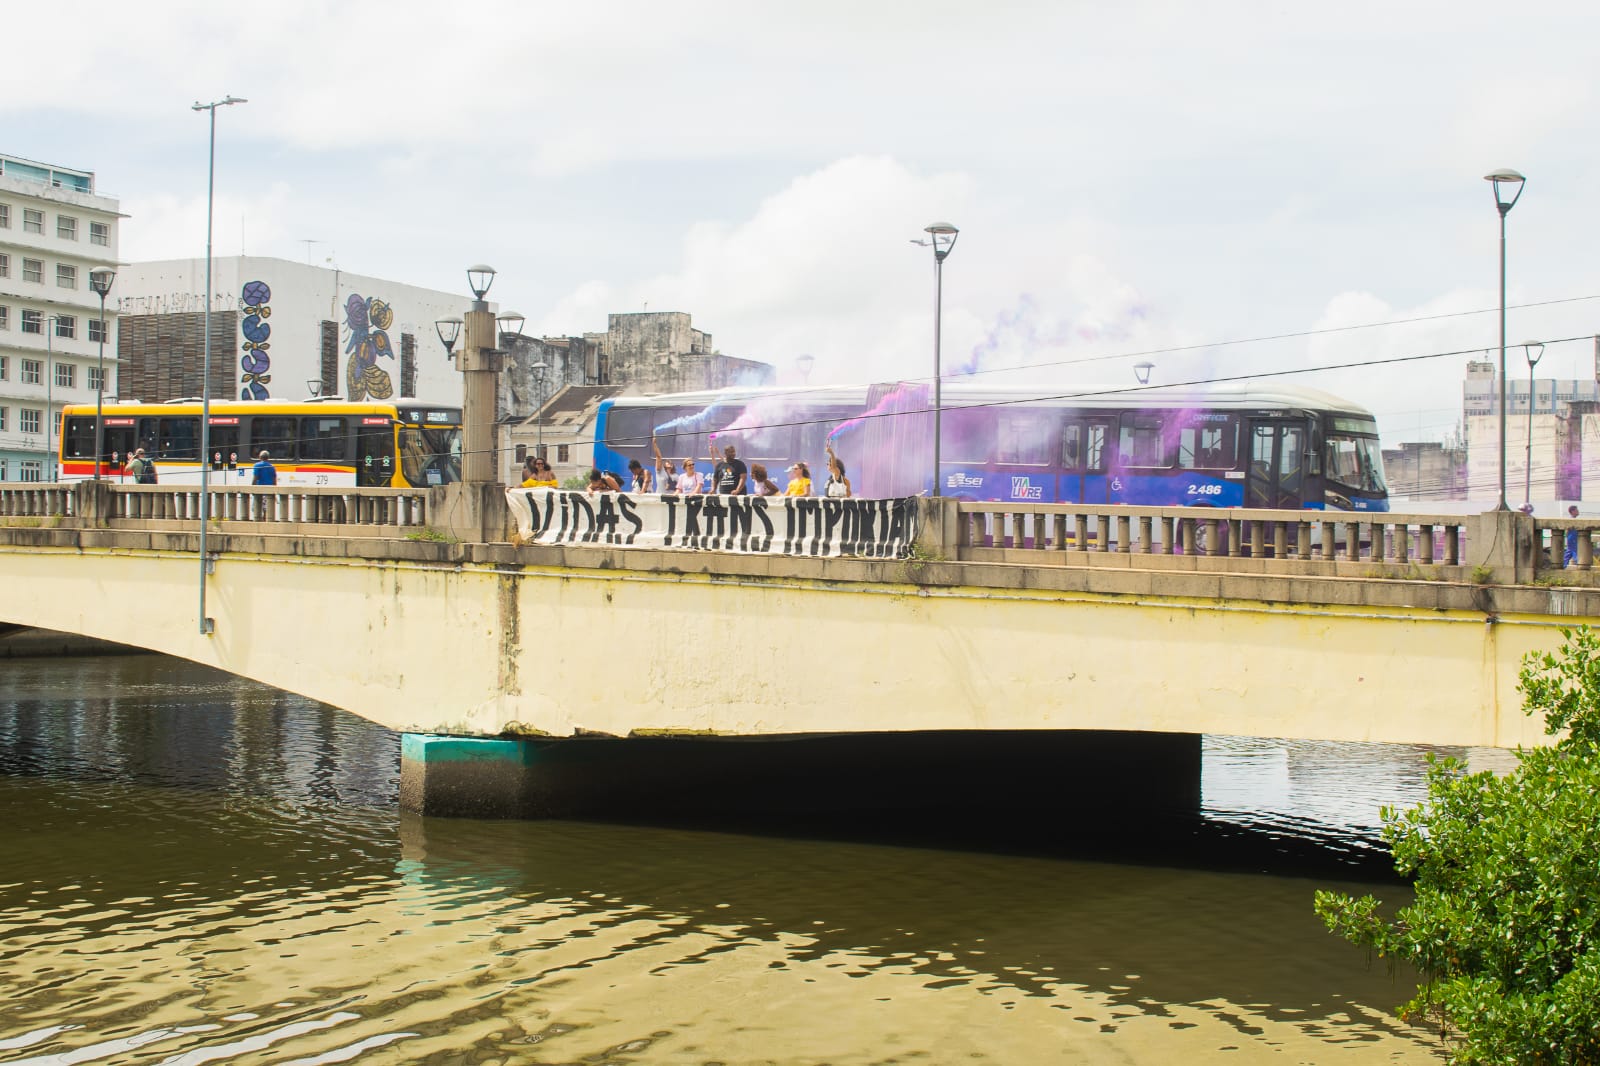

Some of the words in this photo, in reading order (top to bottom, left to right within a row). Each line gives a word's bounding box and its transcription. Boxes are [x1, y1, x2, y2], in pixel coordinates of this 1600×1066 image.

[316, 474, 329, 485] 279
[1011, 476, 1030, 488] VIA
[1010, 487, 1042, 499] LIVRE
[1187, 484, 1223, 495] 2.486
[661, 494, 774, 552] TRANS
